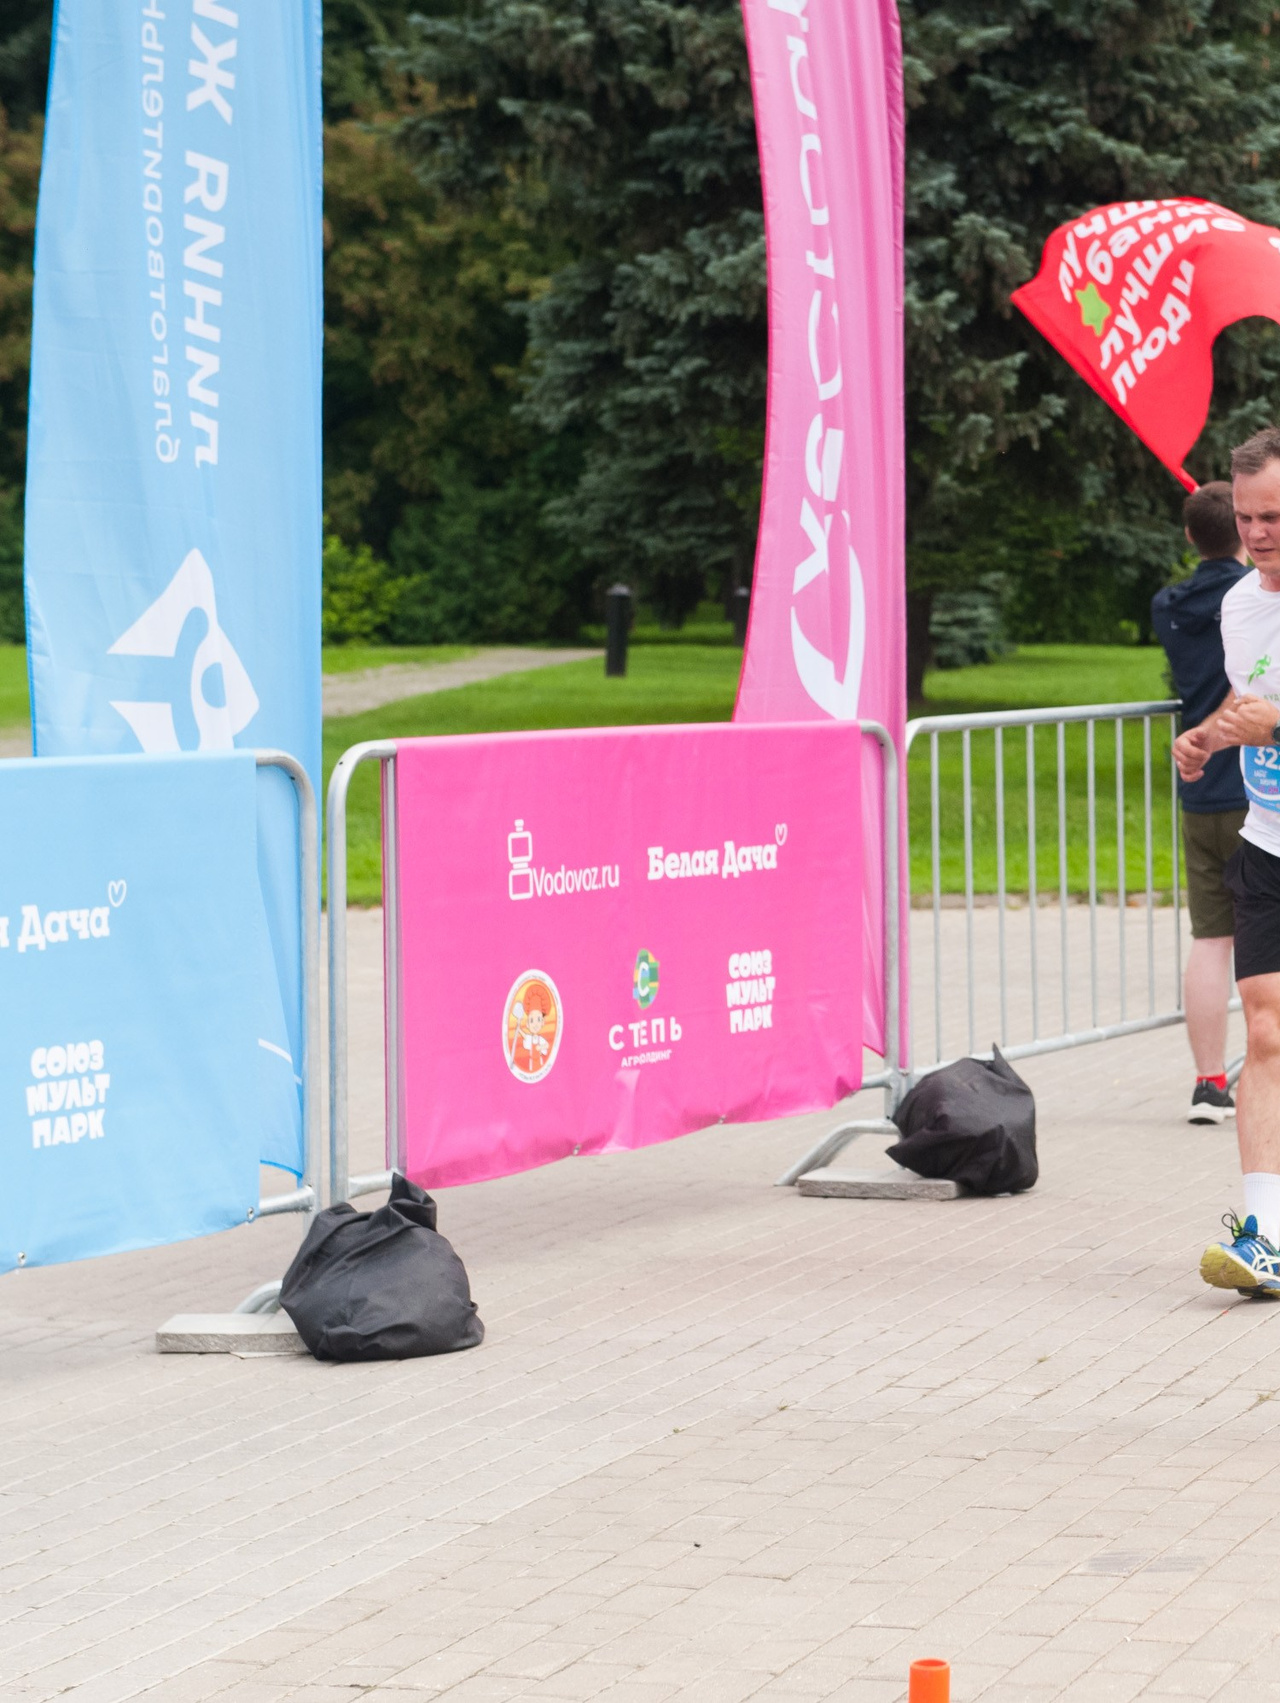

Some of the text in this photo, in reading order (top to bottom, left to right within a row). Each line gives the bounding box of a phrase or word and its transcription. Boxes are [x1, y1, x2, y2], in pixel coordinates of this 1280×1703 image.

[1059, 200, 1196, 303] лучш
[647, 841, 778, 880] Белая Дача
[533, 864, 619, 897] Vodovoz.ru
[18, 905, 110, 953] Дача
[729, 949, 772, 979] СОЮЗ
[726, 976, 776, 1008] МУЛЬТ
[609, 1017, 682, 1050] СТЕПЬ
[730, 1004, 773, 1034] ПАРК
[30, 1040, 104, 1079] СОЮЗ
[26, 1073, 110, 1116] МУЛЬТ
[32, 1109, 105, 1149] ПАРК
